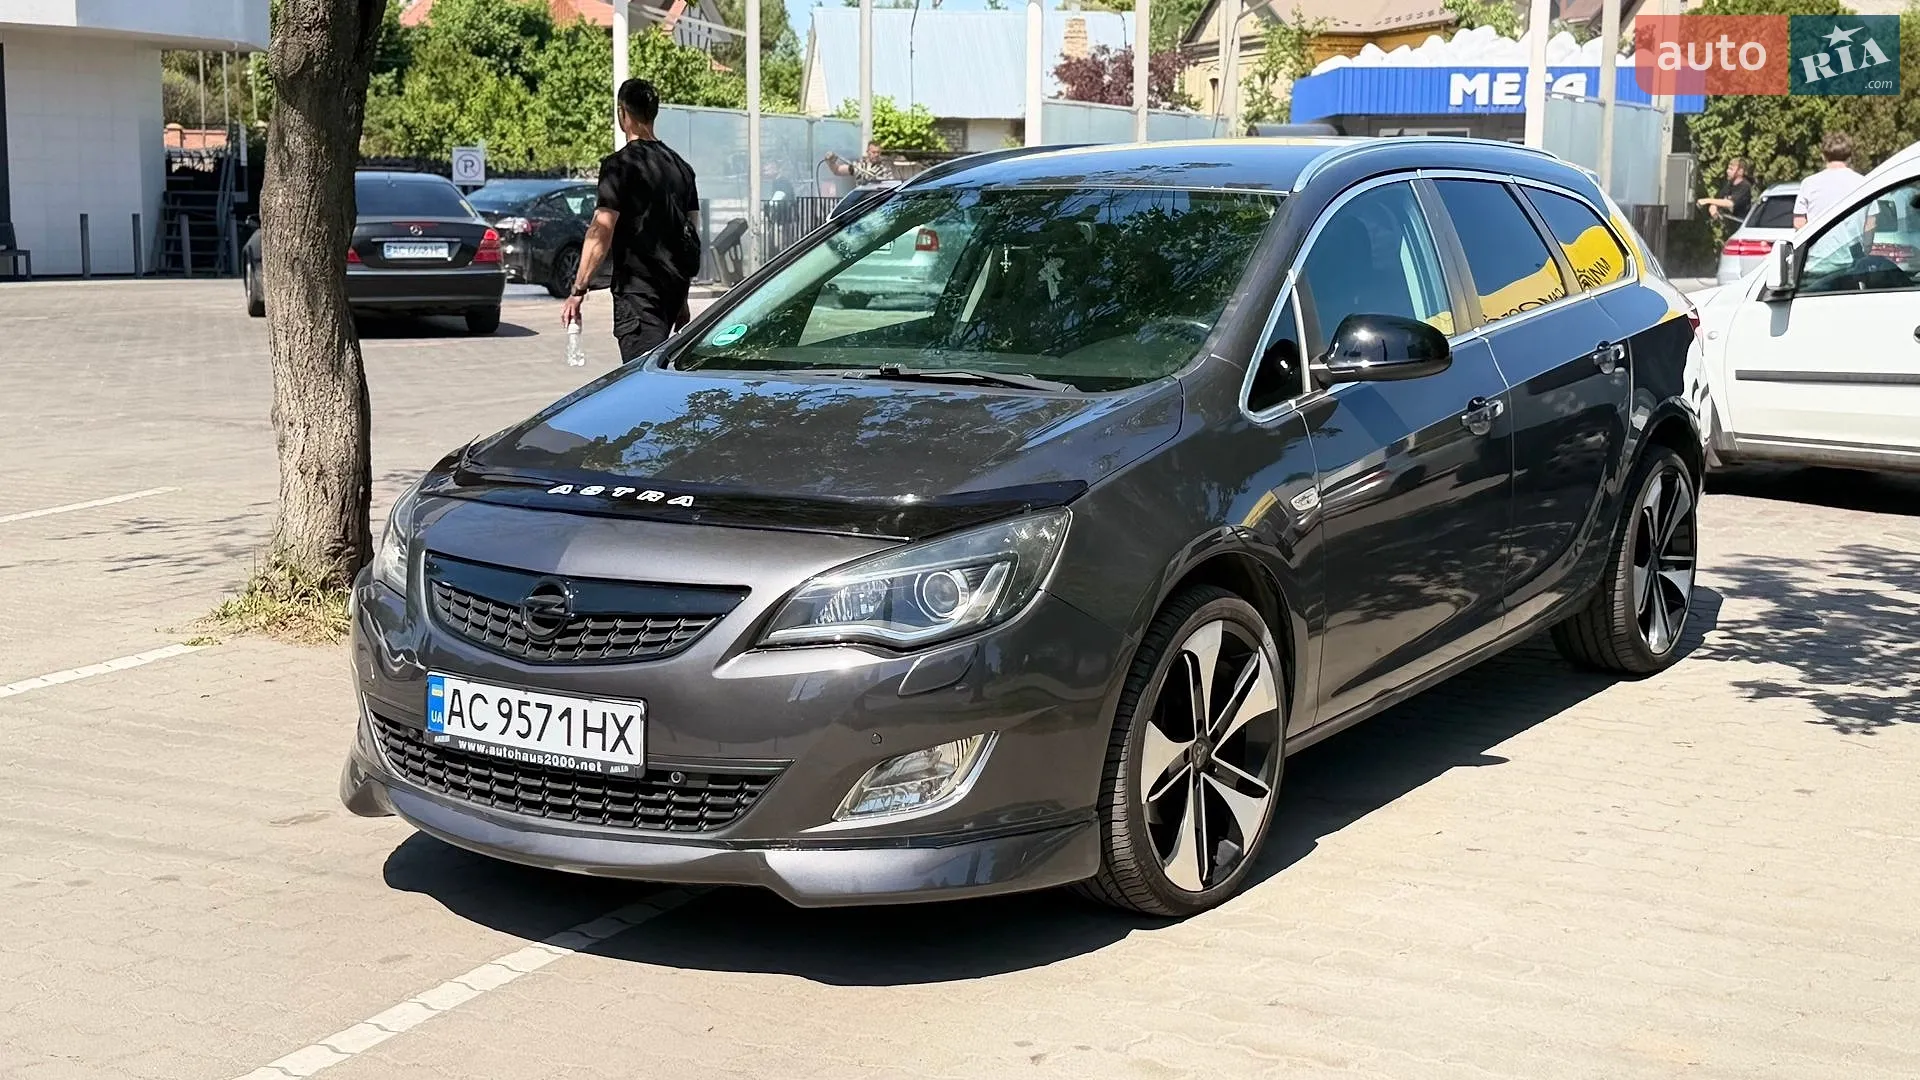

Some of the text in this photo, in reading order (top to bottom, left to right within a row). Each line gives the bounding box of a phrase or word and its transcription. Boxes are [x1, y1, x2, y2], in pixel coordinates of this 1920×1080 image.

[1450, 72, 1588, 105] МЕА
[547, 484, 694, 507] ASTRA
[431, 710, 444, 724] UA
[447, 688, 635, 755] AC 9571 HX
[457, 739, 602, 773] www.autohaus2000.net
